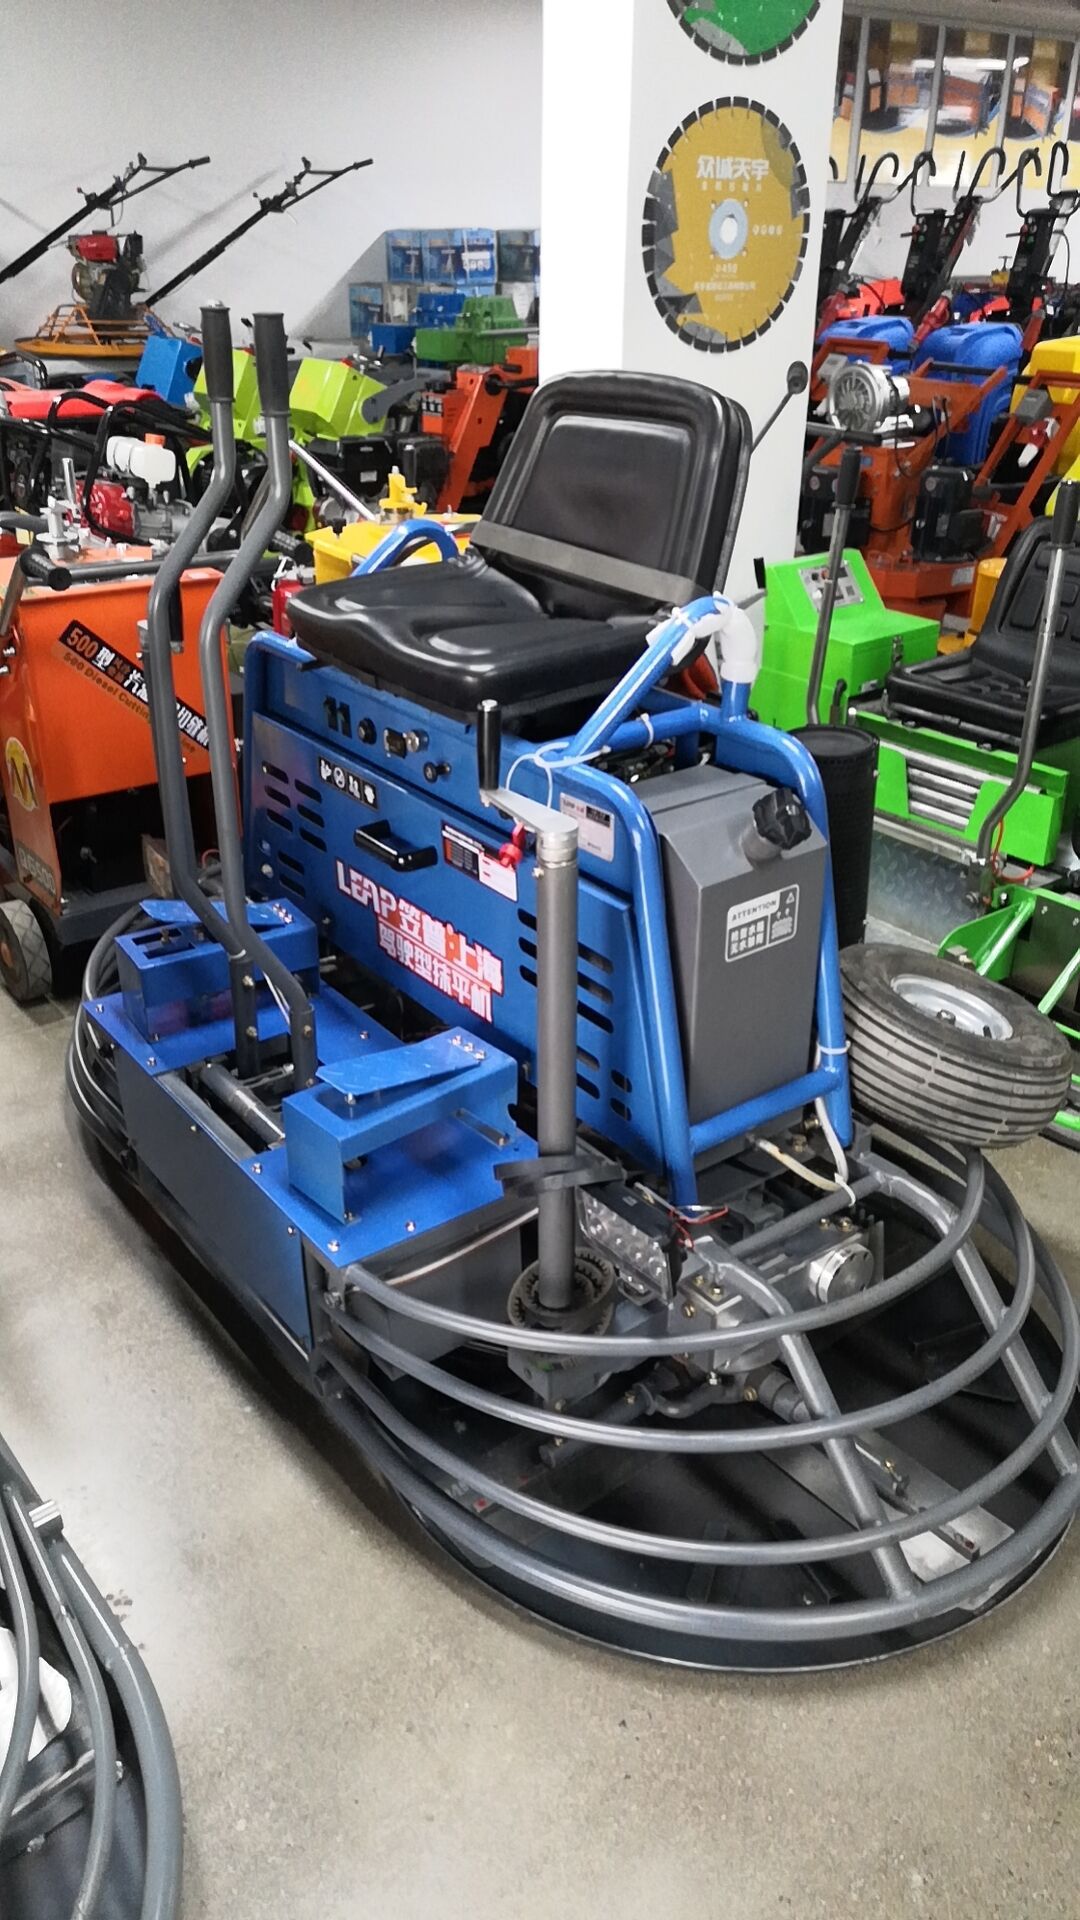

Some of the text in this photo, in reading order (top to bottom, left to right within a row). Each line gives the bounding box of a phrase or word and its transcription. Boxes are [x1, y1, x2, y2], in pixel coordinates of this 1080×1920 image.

[84, 665, 117, 696] Diesel
[117, 692, 151, 725] Cuttin
[731, 900, 777, 921] ATTENTION
